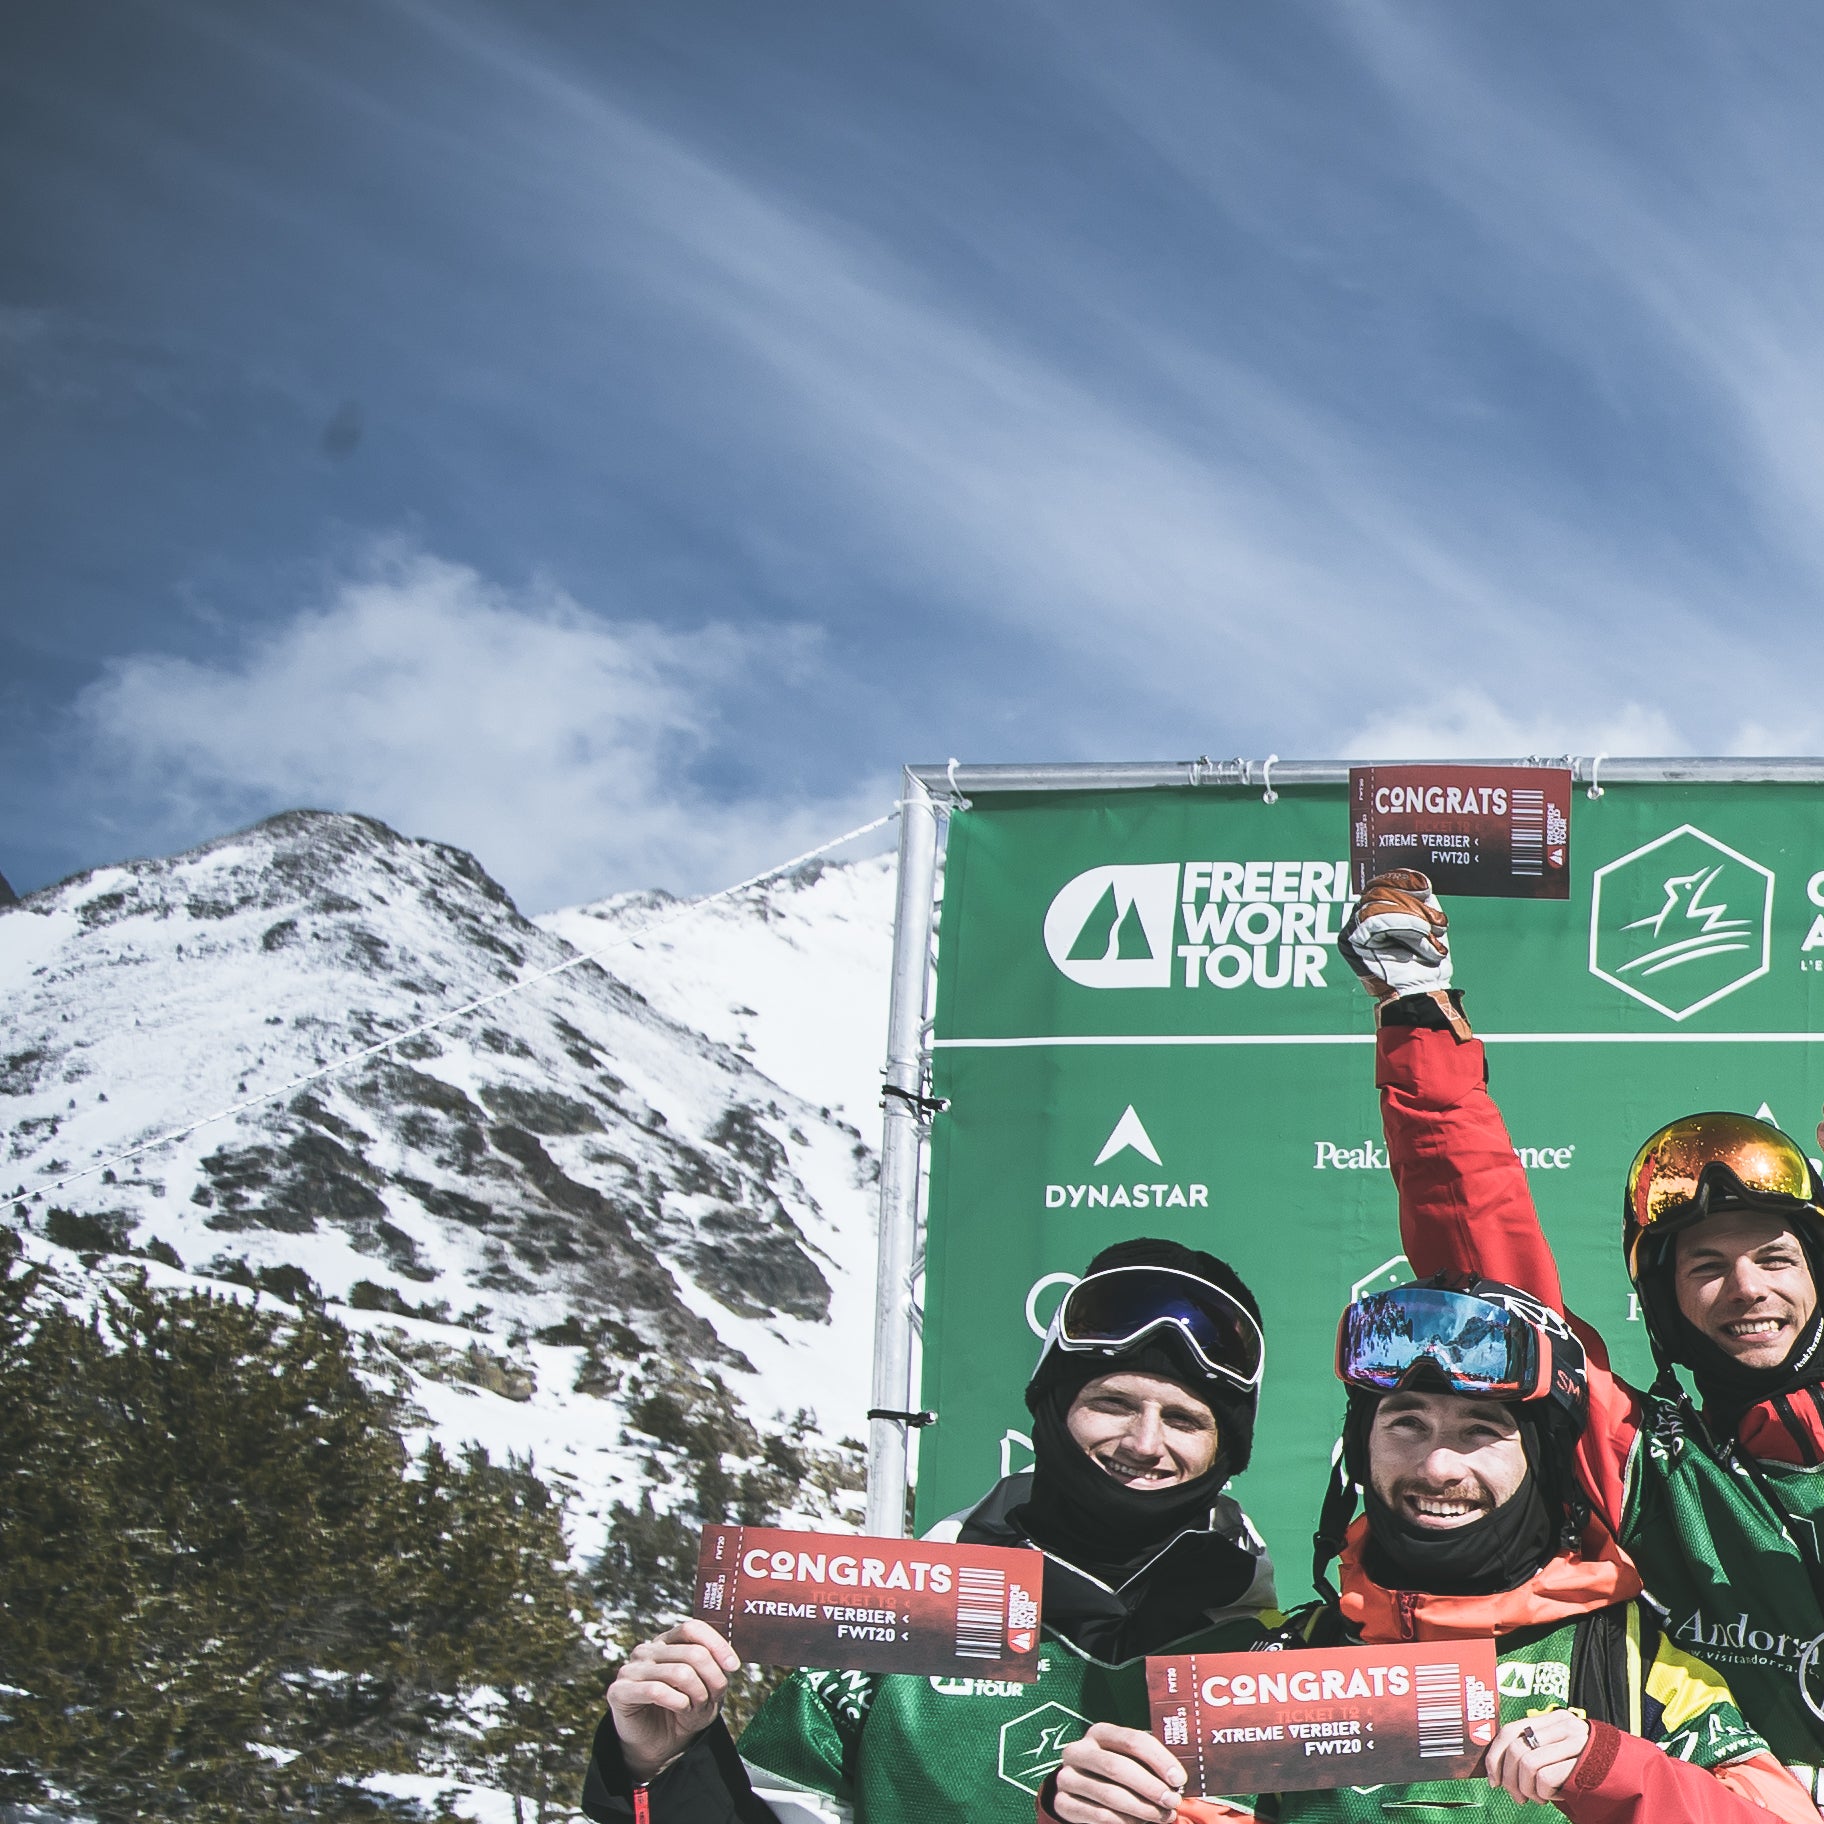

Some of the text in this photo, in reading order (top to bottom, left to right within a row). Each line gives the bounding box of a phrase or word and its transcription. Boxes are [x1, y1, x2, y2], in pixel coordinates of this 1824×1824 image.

[1374, 786, 1508, 815] CONGRATS
[1378, 834, 1470, 848] XTREME VERBIER
[1431, 851, 1470, 865] FWT20
[1182, 903, 1352, 945] WORL
[1177, 946, 1328, 989] TOUR
[1045, 1184, 1210, 1209] DYNASTAR
[742, 1548, 953, 1594] CONGRATS
[744, 1600, 897, 1625] XTREME VERBIER
[837, 1624, 896, 1643] FWT20
[1201, 1665, 1411, 1708] CONGRATS
[1211, 1720, 1361, 1745] XTREME VERBIER
[1304, 1738, 1362, 1757] FWT20
